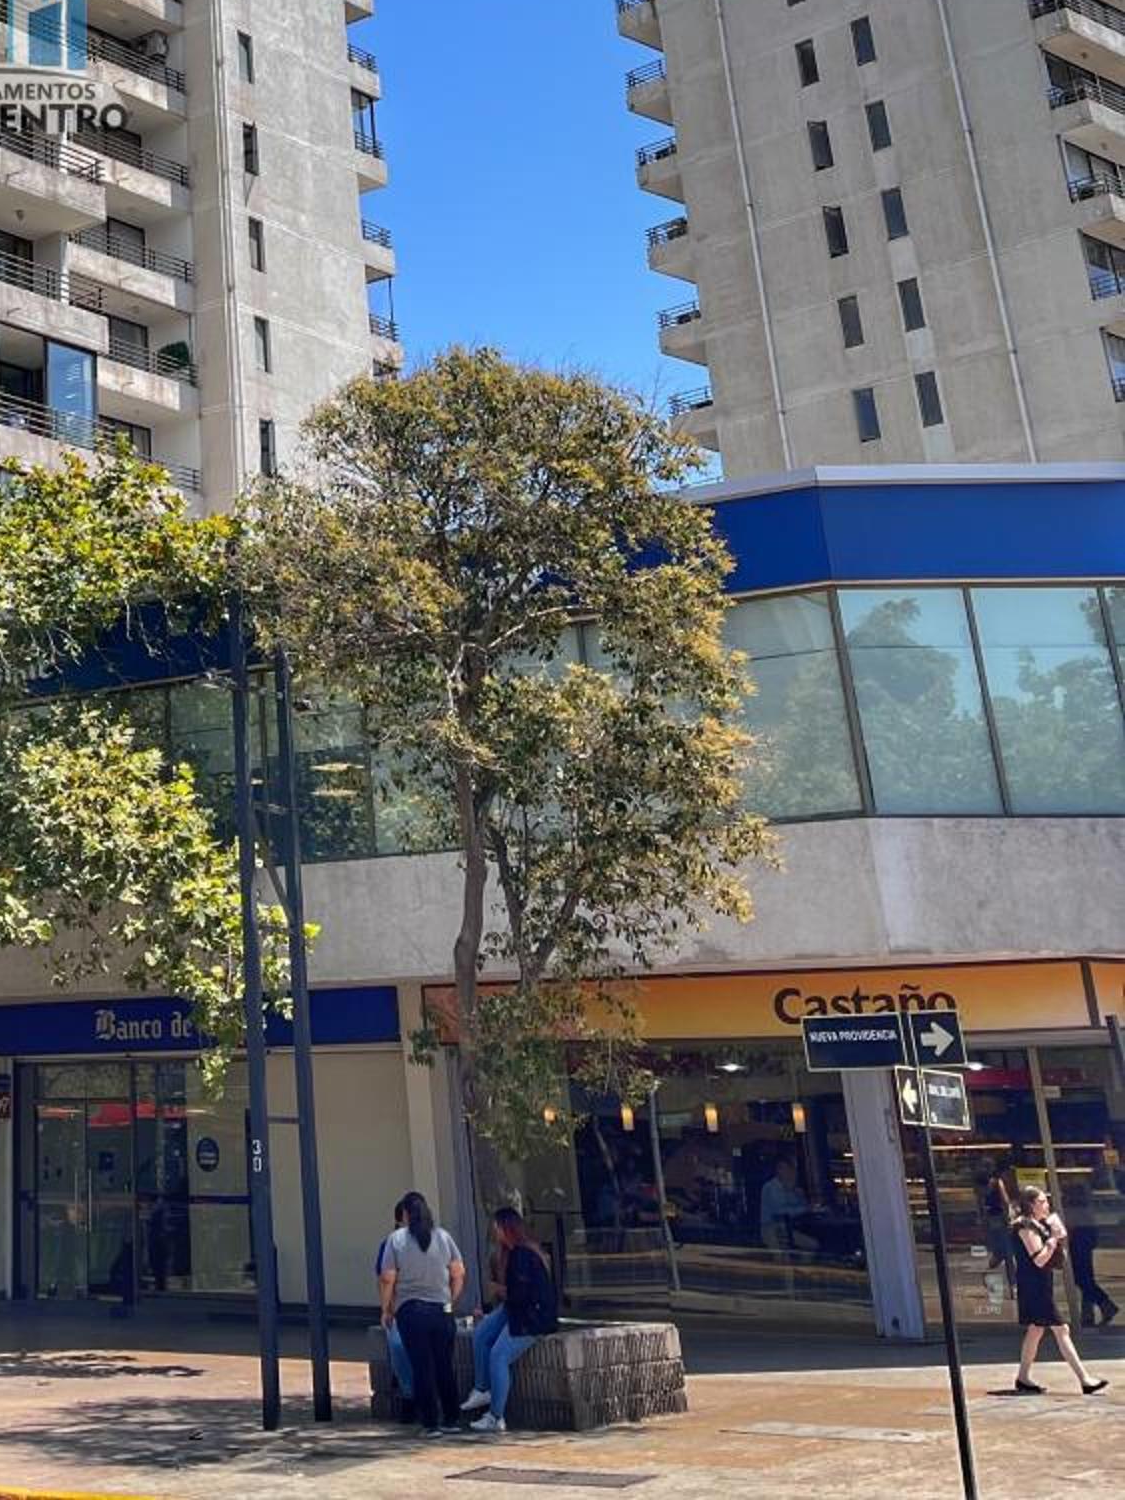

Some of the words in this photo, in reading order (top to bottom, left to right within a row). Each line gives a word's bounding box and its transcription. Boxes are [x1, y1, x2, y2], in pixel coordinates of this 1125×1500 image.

[774, 983, 957, 1025] Castaño
[94, 1008, 162, 1041] Banco
[809, 1030, 838, 1043] NUEVA
[839, 1029, 898, 1042] PROVIDENCIA
